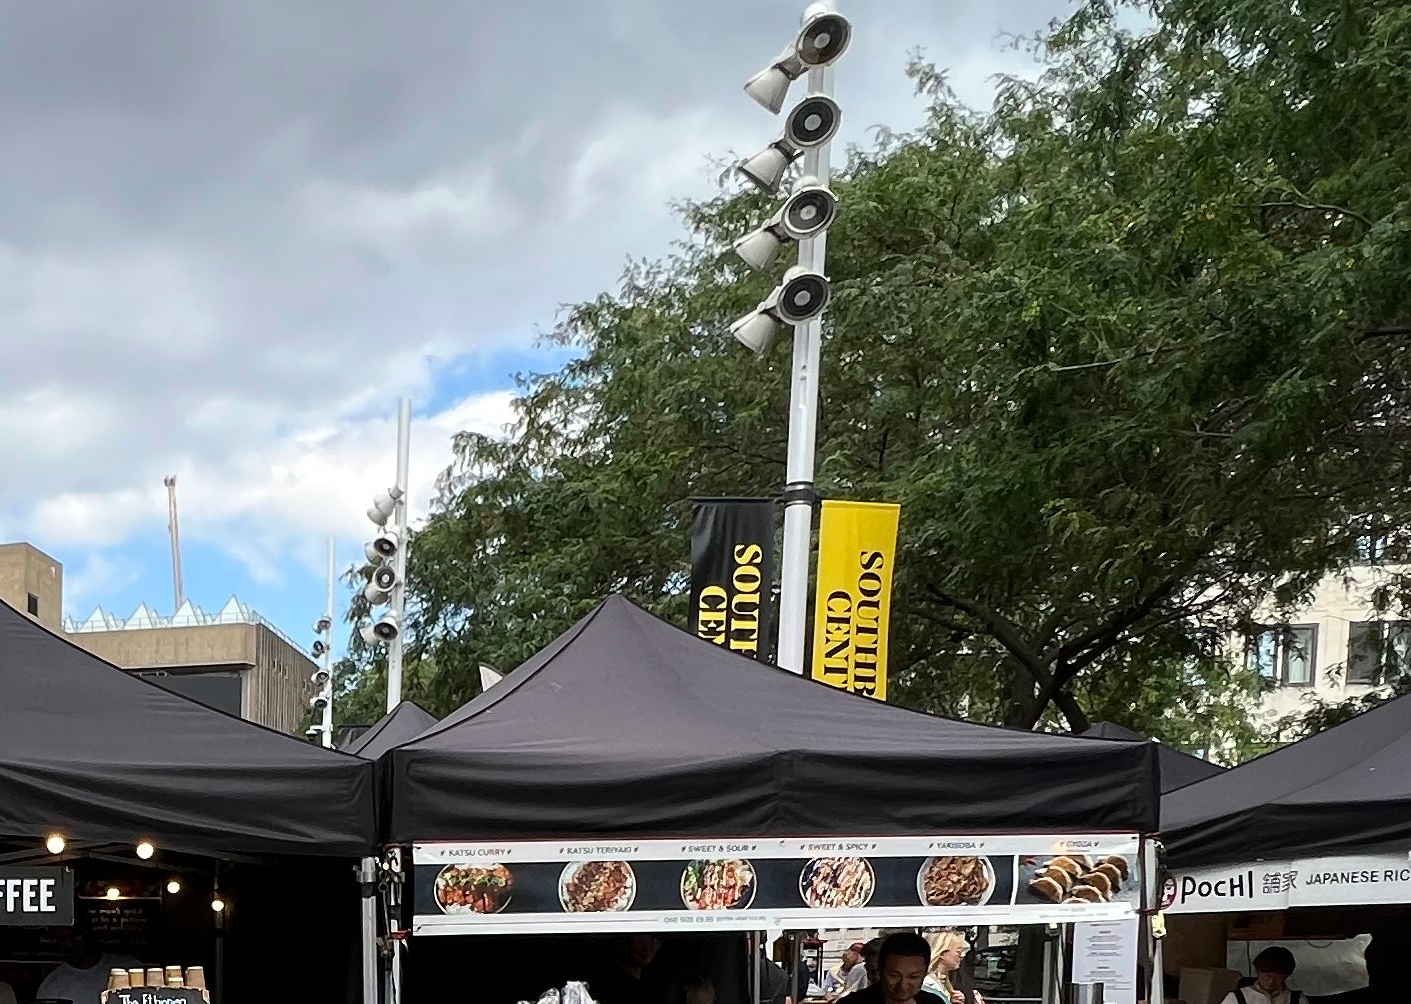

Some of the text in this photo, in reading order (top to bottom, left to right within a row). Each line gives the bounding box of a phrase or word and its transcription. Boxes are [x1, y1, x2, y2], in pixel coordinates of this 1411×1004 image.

[567, 847, 595, 855] KATSU
[688, 845, 717, 853] SWEET
[726, 844, 750, 852] SOUR
[808, 843, 837, 851] SWEET
[845, 843, 869, 851] SPICY
[449, 848, 506, 857] KATSU CURRY
[1305, 870, 1380, 886] JAPANESE
